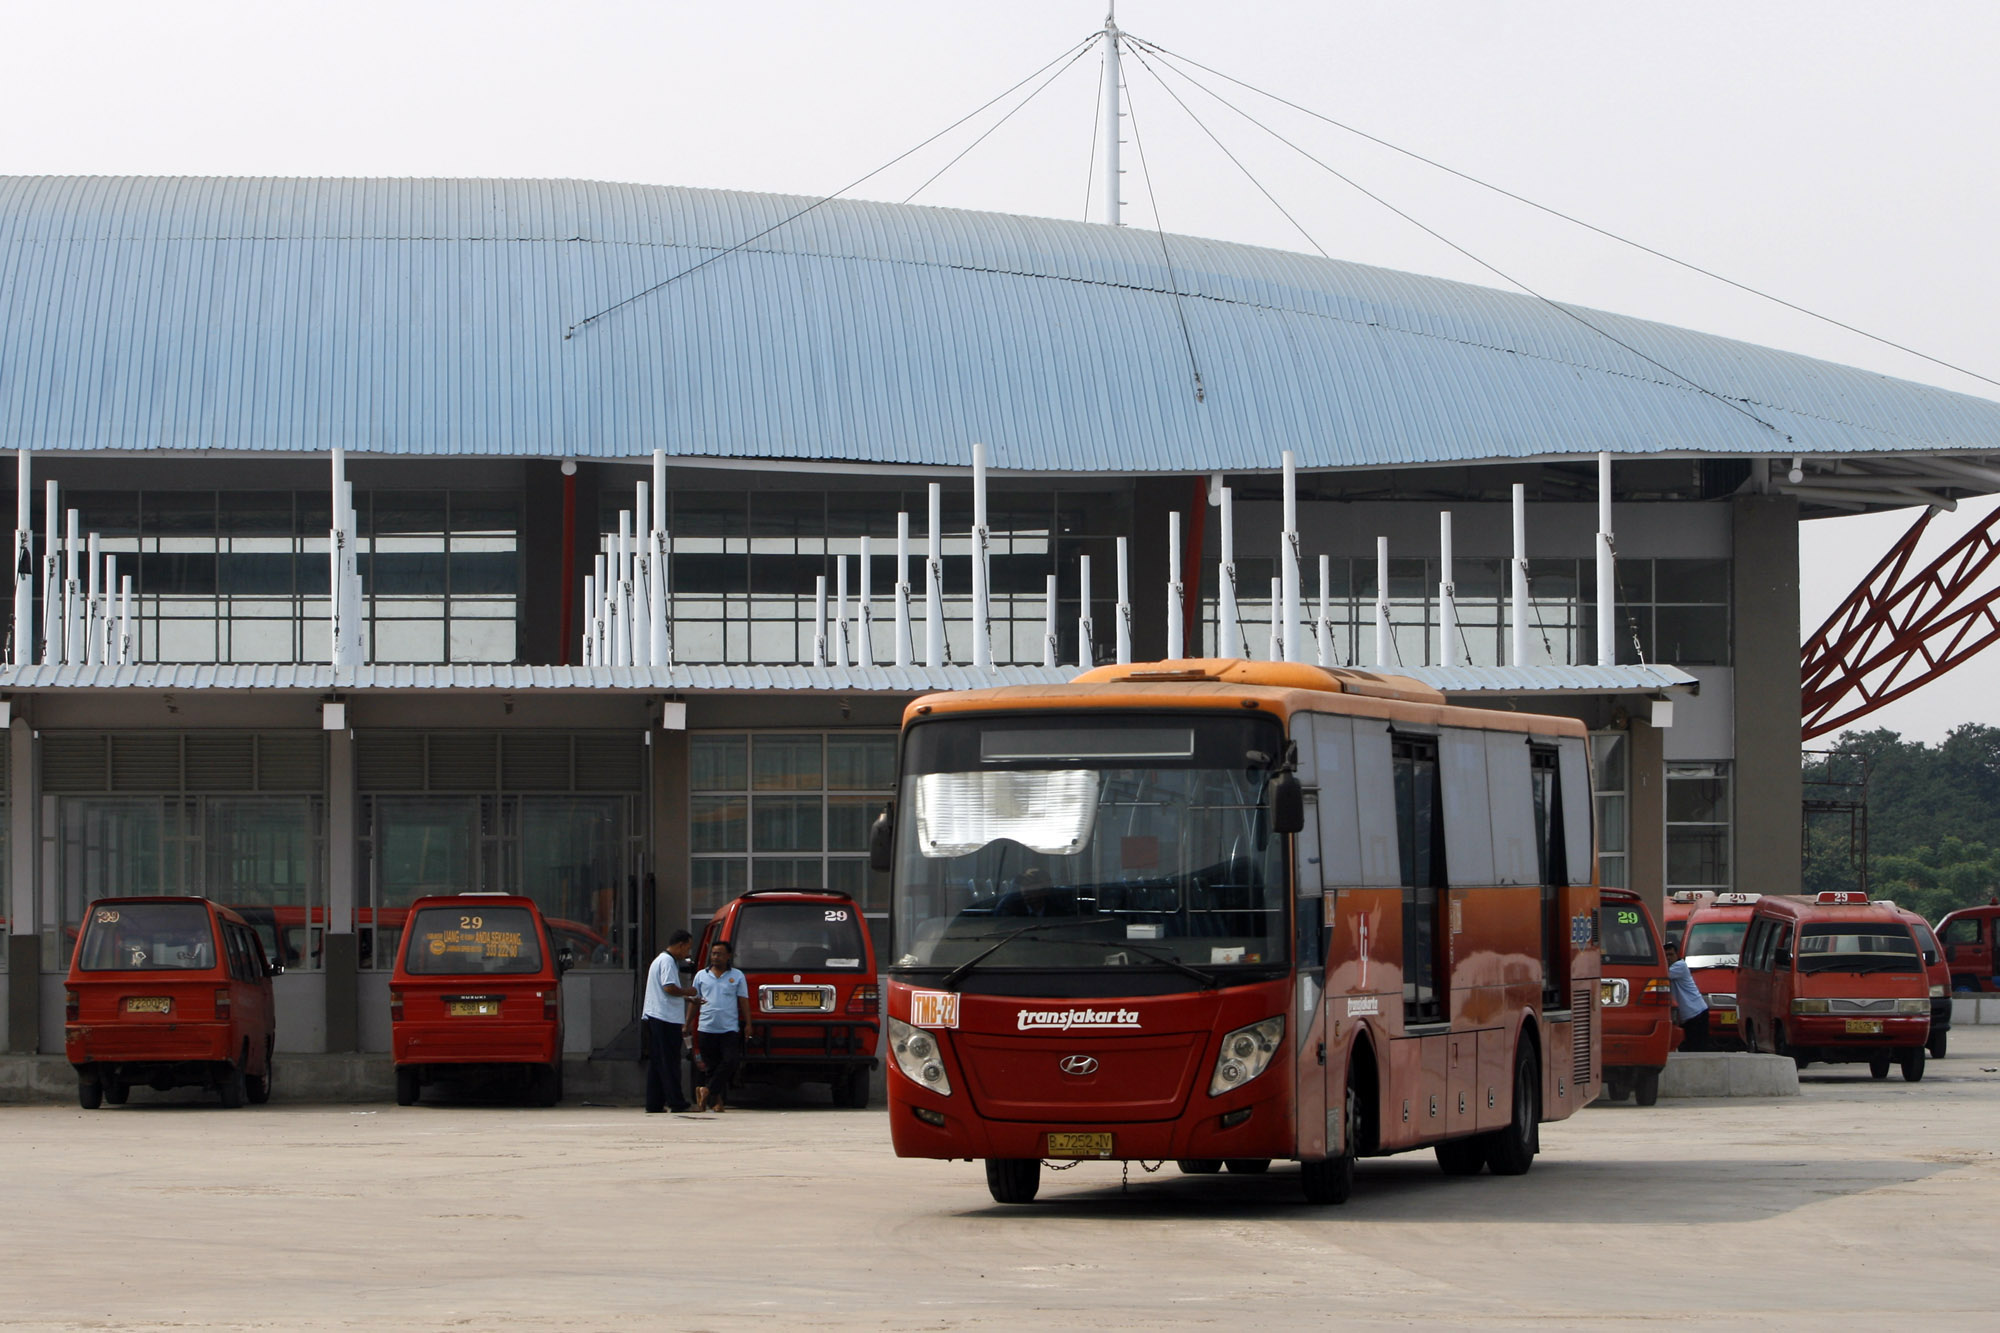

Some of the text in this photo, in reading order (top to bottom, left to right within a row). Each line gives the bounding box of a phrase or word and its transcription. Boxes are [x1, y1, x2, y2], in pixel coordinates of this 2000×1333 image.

[1730, 894, 1746, 903] 29
[1834, 892, 1848, 903] 29
[460, 916, 483, 929] 29
[825, 910, 848, 922] 29
[1617, 911, 1639, 925] 29
[916, 996, 955, 1024] TMB-22
[1017, 1009, 1142, 1031] transjakarta
[1049, 1135, 1056, 1148] B
[1064, 1134, 1094, 1148] 7252
